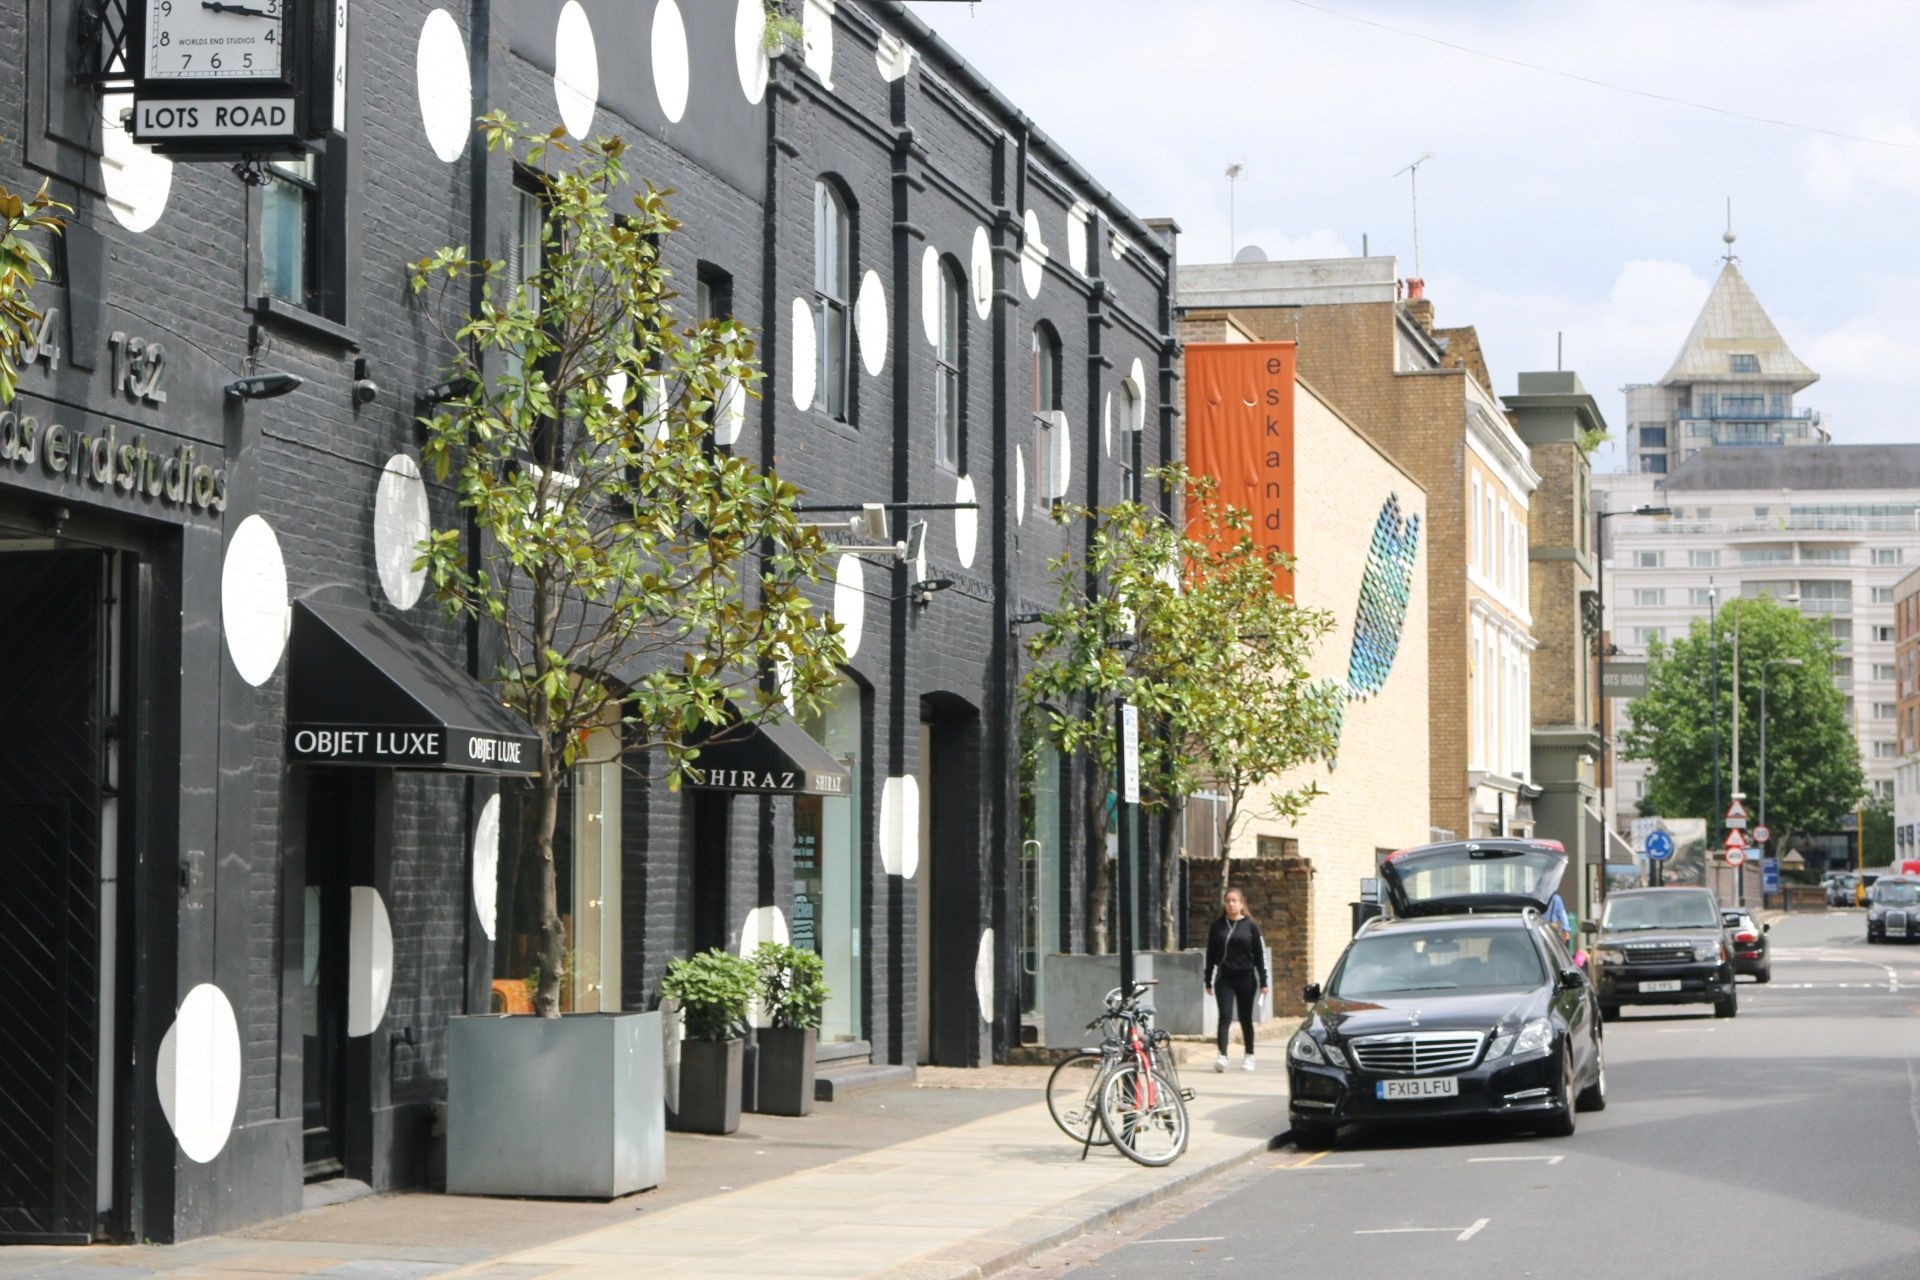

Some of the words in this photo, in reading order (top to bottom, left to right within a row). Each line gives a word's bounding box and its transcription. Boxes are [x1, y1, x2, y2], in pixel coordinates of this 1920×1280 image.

[161, 1, 172, 17] 9
[267, 0, 277, 13] 3
[338, 6, 344, 28] 3
[160, 31, 170, 46] 8
[179, 38, 208, 46] WORLDS
[226, 37, 255, 45] STUDIOS
[264, 29, 276, 44] 4
[181, 54, 192, 70] 7
[211, 53, 222, 69] 6
[242, 53, 253, 68] 5
[336, 65, 343, 88] 4
[144, 107, 199, 130] LOTS
[215, 106, 287, 128] ROAD
[109, 331, 167, 403] 132
[294, 730, 369, 756] OBJET
[376, 732, 440, 755] LUXE
[468, 736, 497, 763] OBJET
[497, 741, 522, 763] LUXE
[815, 774, 841, 792] SHIRAZ
[1388, 1082, 1420, 1096] FX13
